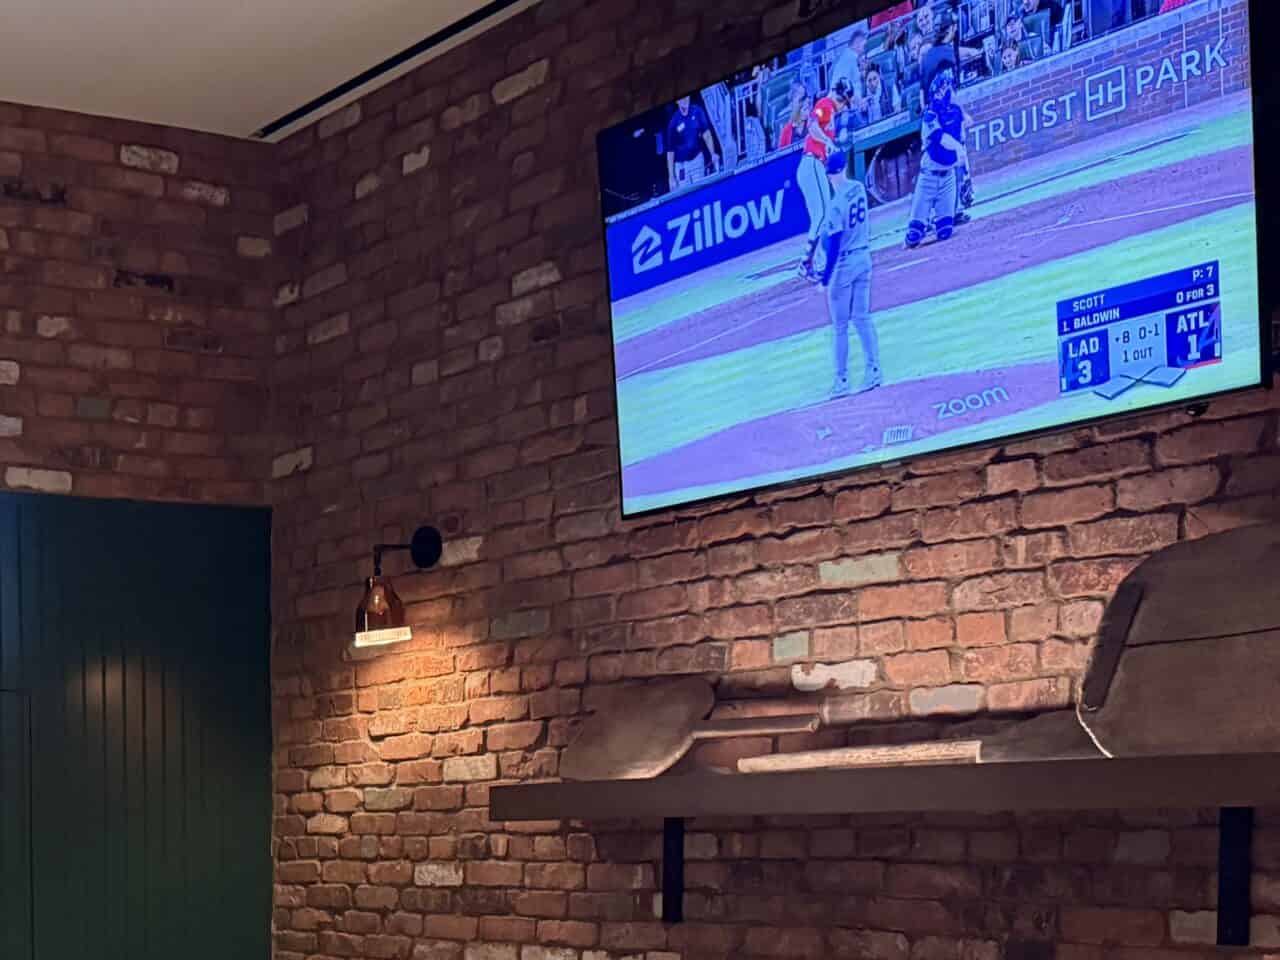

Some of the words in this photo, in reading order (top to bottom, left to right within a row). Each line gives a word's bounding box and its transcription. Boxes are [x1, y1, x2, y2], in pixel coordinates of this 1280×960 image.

[969, 91, 1077, 151] TRUIST
[1135, 38, 1228, 96] PARK
[666, 188, 785, 262] Zillow
[1192, 269, 1204, 281] P:
[1206, 265, 1214, 278] 7
[1072, 294, 1105, 312] SCOTT
[1186, 287, 1204, 302] FOR
[1206, 284, 1215, 297] 3
[1073, 307, 1120, 326] BALDWIN
[1176, 310, 1209, 334] ATL
[1068, 337, 1099, 358] LAD
[1123, 350, 1129, 363] 1
[1133, 346, 1153, 361] OUT
[1187, 334, 1201, 361] 1
[1077, 359, 1092, 385] 3
[932, 385, 1010, 420] zoom
